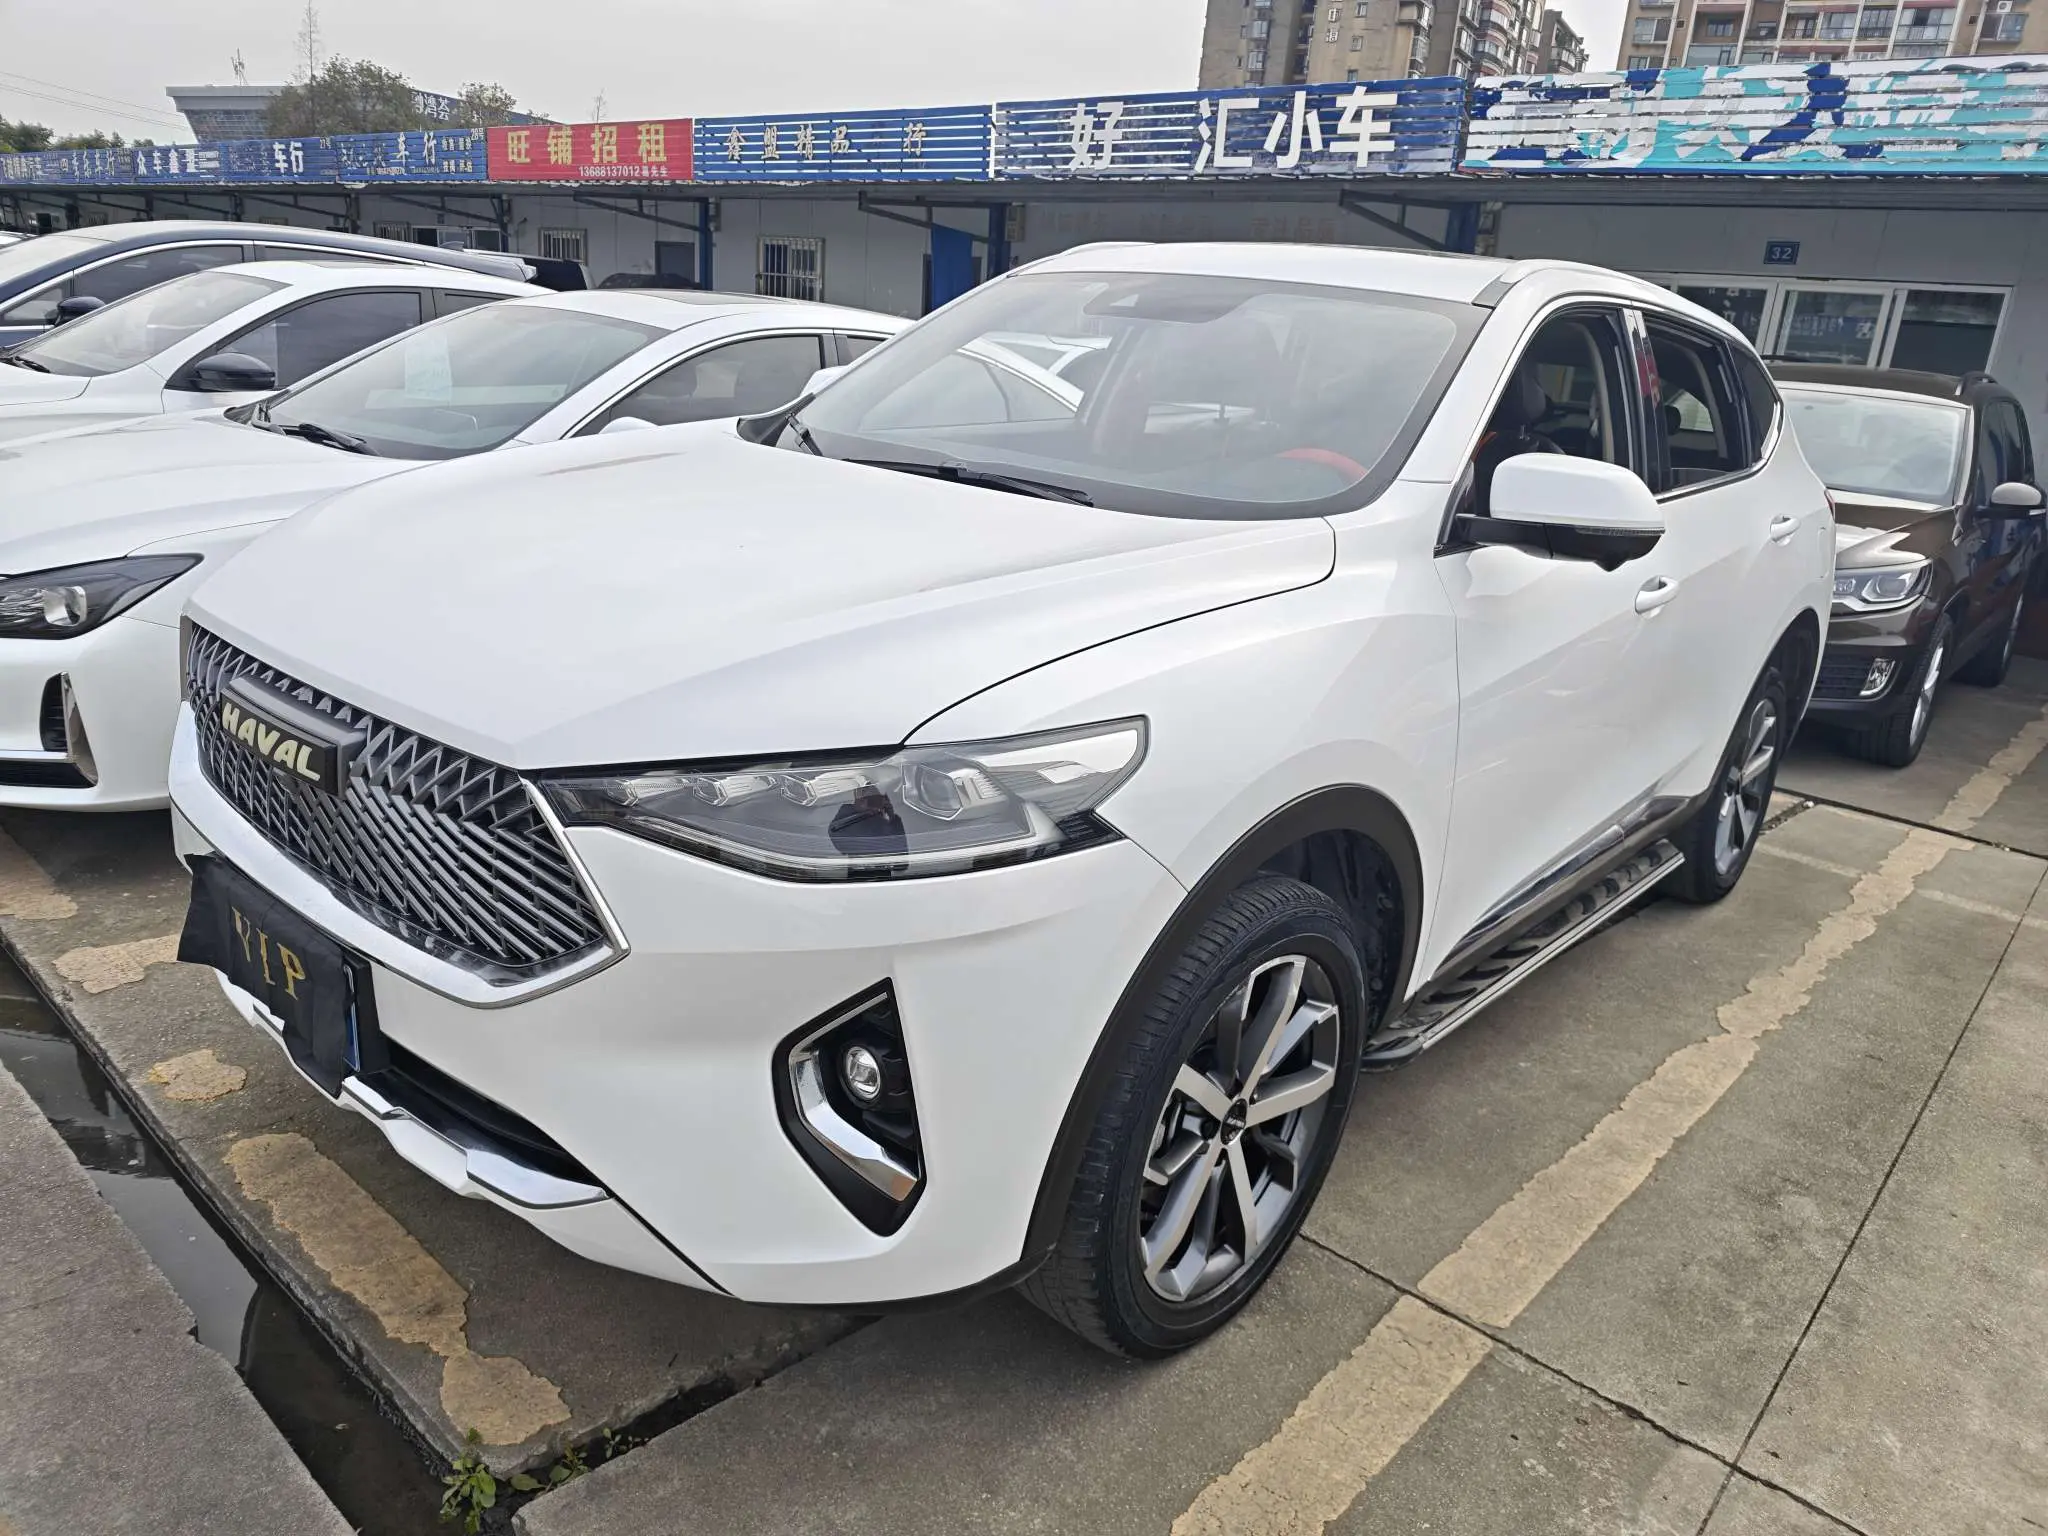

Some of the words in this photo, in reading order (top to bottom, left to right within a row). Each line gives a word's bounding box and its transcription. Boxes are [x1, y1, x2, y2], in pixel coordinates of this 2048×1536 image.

[272, 140, 305, 174] 车行
[506, 122, 668, 166] 旺铺招租
[1771, 246, 1793, 260] 32
[222, 702, 321, 781] HAVAL
[231, 906, 306, 1000] VIP
